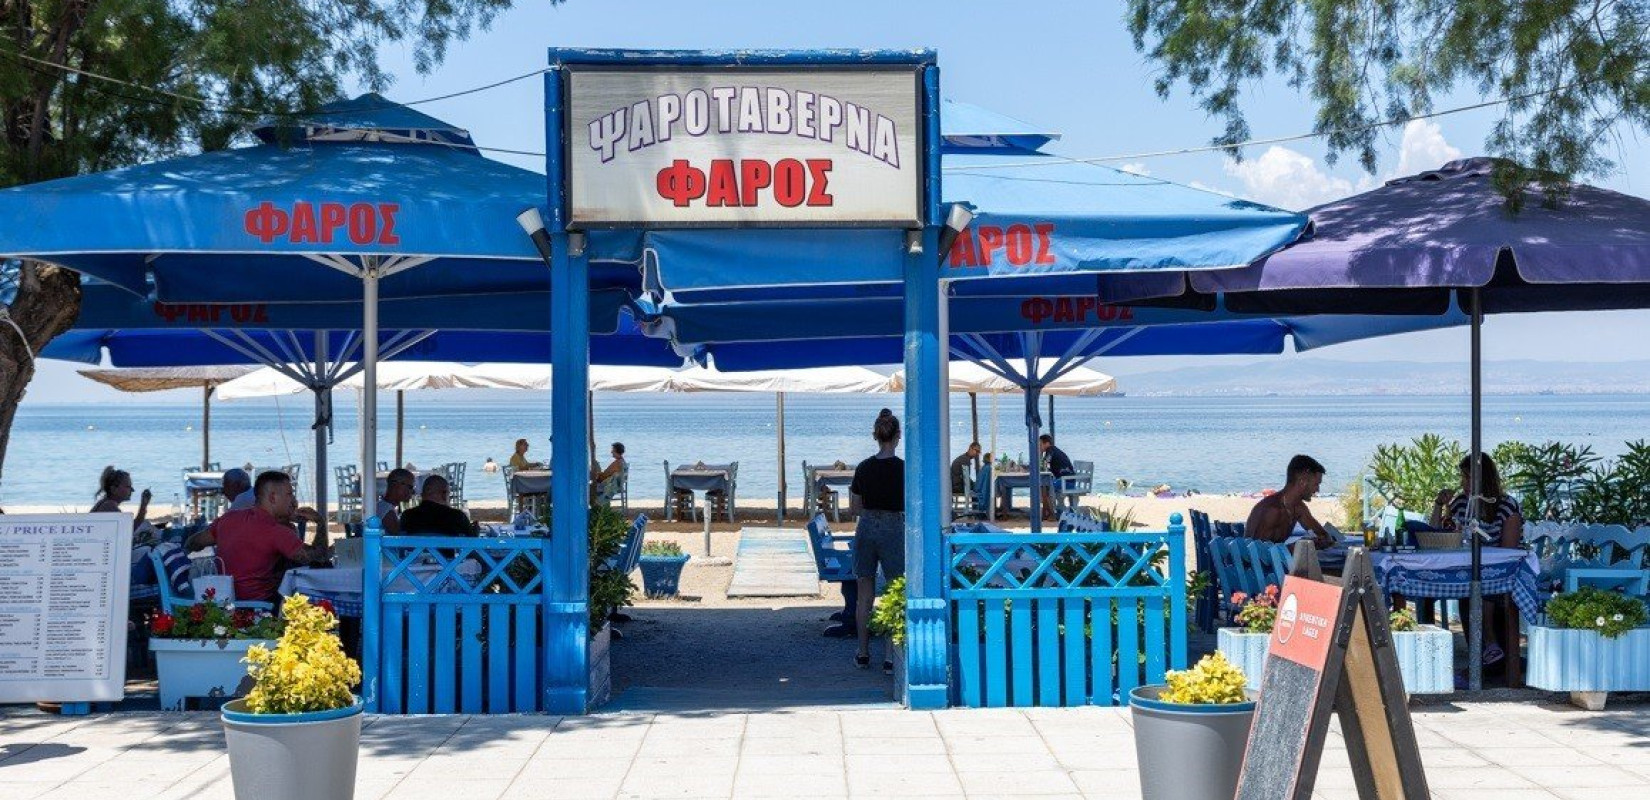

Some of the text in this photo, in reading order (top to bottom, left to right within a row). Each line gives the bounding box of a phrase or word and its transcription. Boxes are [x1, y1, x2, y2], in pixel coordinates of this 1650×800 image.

[587, 86, 901, 169] ΨΑΡΟΤΑΒΕΡΝΑ
[656, 158, 833, 207] ΦΑΡΟΣ
[244, 201, 401, 245] ΦΑΡΟΣ
[949, 222, 1056, 268] ΑΡΟΣ
[13, 525, 58, 535] PRICE
[61, 525, 95, 534] LIST
